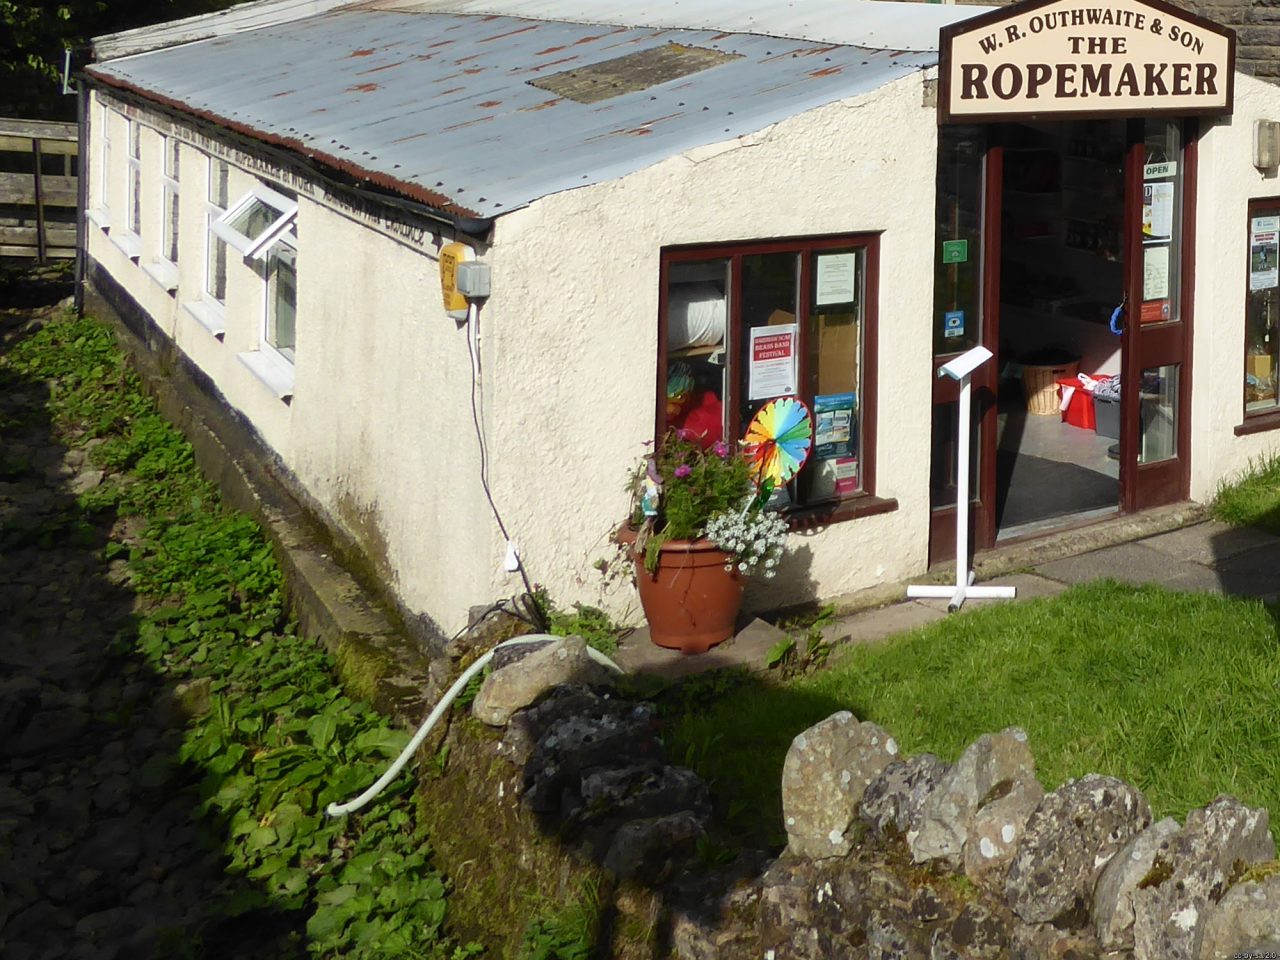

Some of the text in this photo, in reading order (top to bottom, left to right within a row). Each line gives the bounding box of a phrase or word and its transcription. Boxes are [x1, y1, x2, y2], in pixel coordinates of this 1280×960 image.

[978, 8, 1205, 56] W. R. OUTHWAITE & SON
[1067, 36, 1128, 55] THE
[960, 62, 1218, 101] ROPEMAKER
[1146, 165, 1169, 175] OPEN
